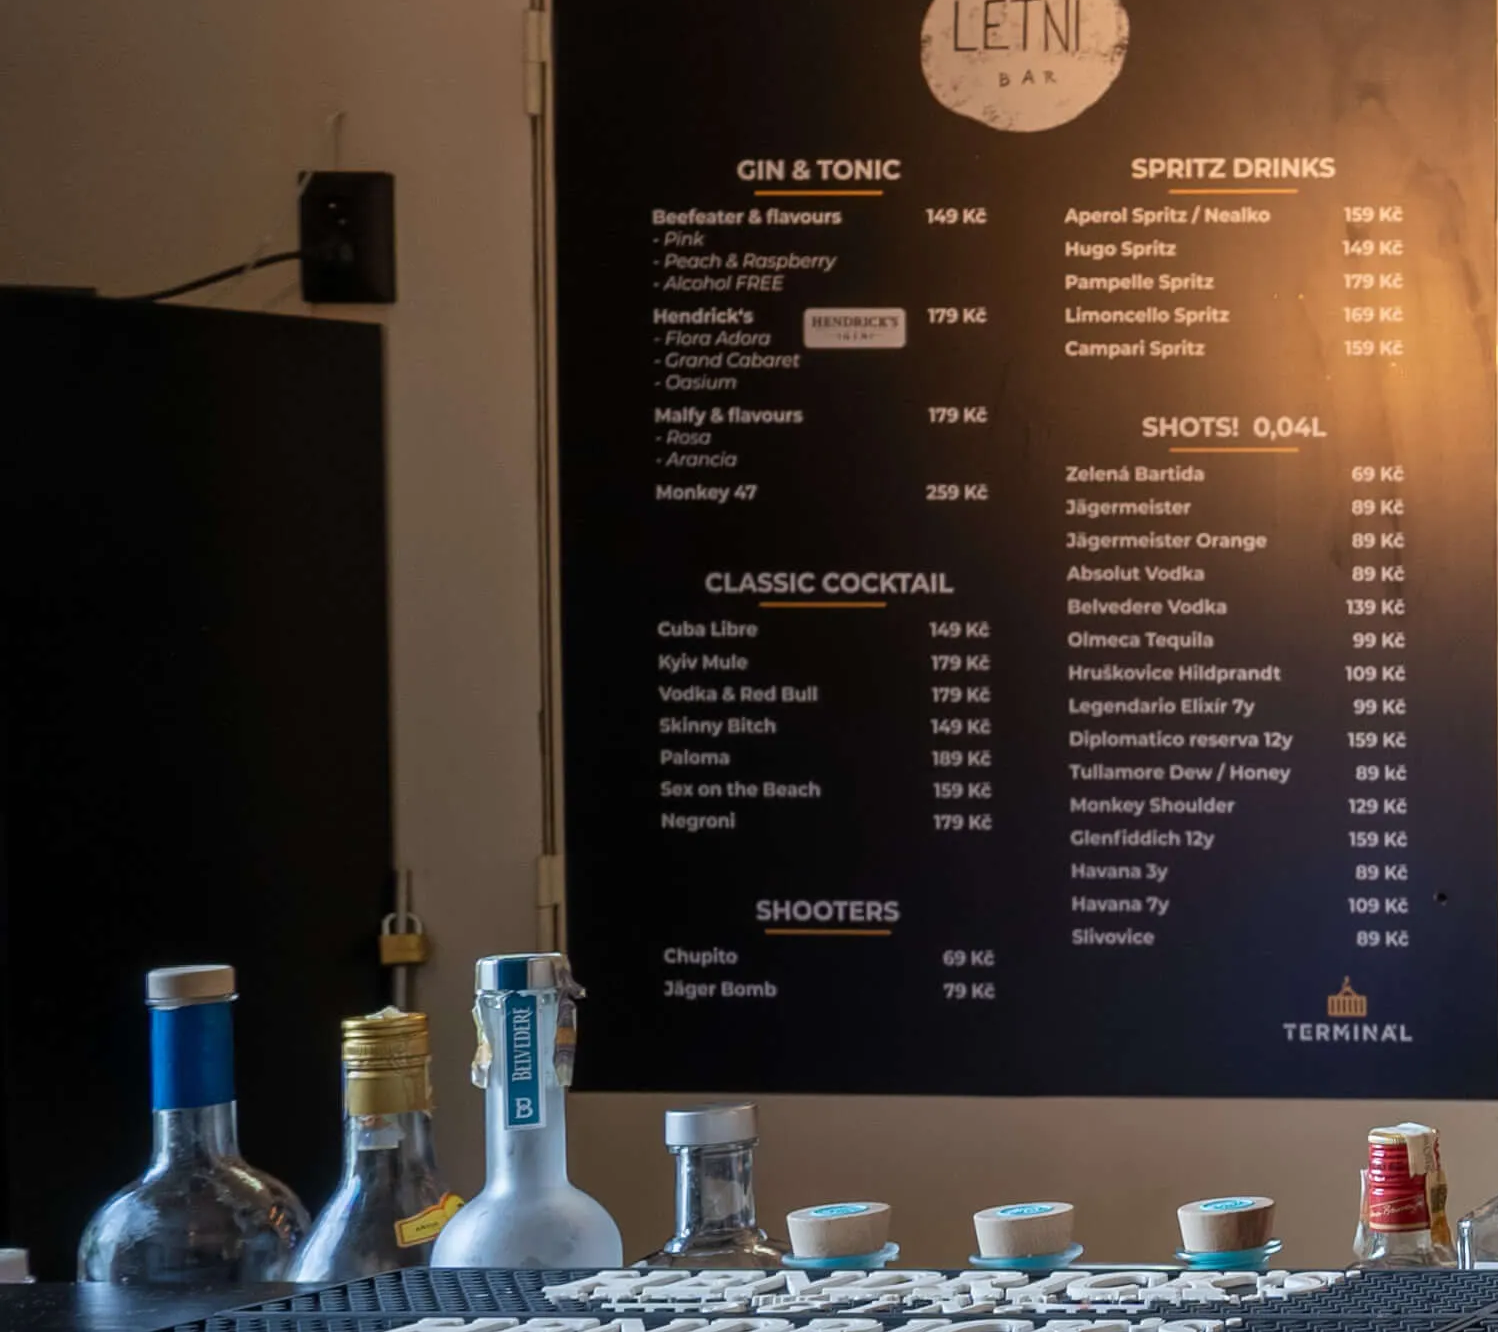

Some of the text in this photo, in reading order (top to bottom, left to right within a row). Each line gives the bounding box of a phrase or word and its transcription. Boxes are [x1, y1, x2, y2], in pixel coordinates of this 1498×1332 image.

[997, 69, 1057, 88] BAR
[736, 158, 901, 182] GIN & TONIC
[1130, 156, 1336, 180] SPRITZ DRINKS
[652, 207, 987, 226] Beefeater & flavours 149 Kč
[1063, 204, 1404, 227] Aperol Spritz / Nealko 159 Kč
[652, 306, 988, 325] Hendrick's 179 Kč
[1141, 416, 1328, 441] SHOTS! 0,04L
[655, 483, 989, 505] Monkey 47 259 Kč
[1065, 531, 1405, 552] Jägermeister Orange 89 Kč
[704, 571, 955, 594] CLASSIC COCKTAIL
[656, 619, 990, 639] Cuba Libre 149 Kč
[1068, 663, 1406, 685] Hruškovice Hildprandt 109 Kč
[659, 748, 992, 767] Paloma 189 Kč
[1069, 828, 1408, 851] Glenfiddich 12y 159 Kč
[755, 899, 901, 923] SHOOTERS
[663, 946, 995, 968] Chupito 69 Kč
[511, 1006, 532, 1082] BELVEDERE
